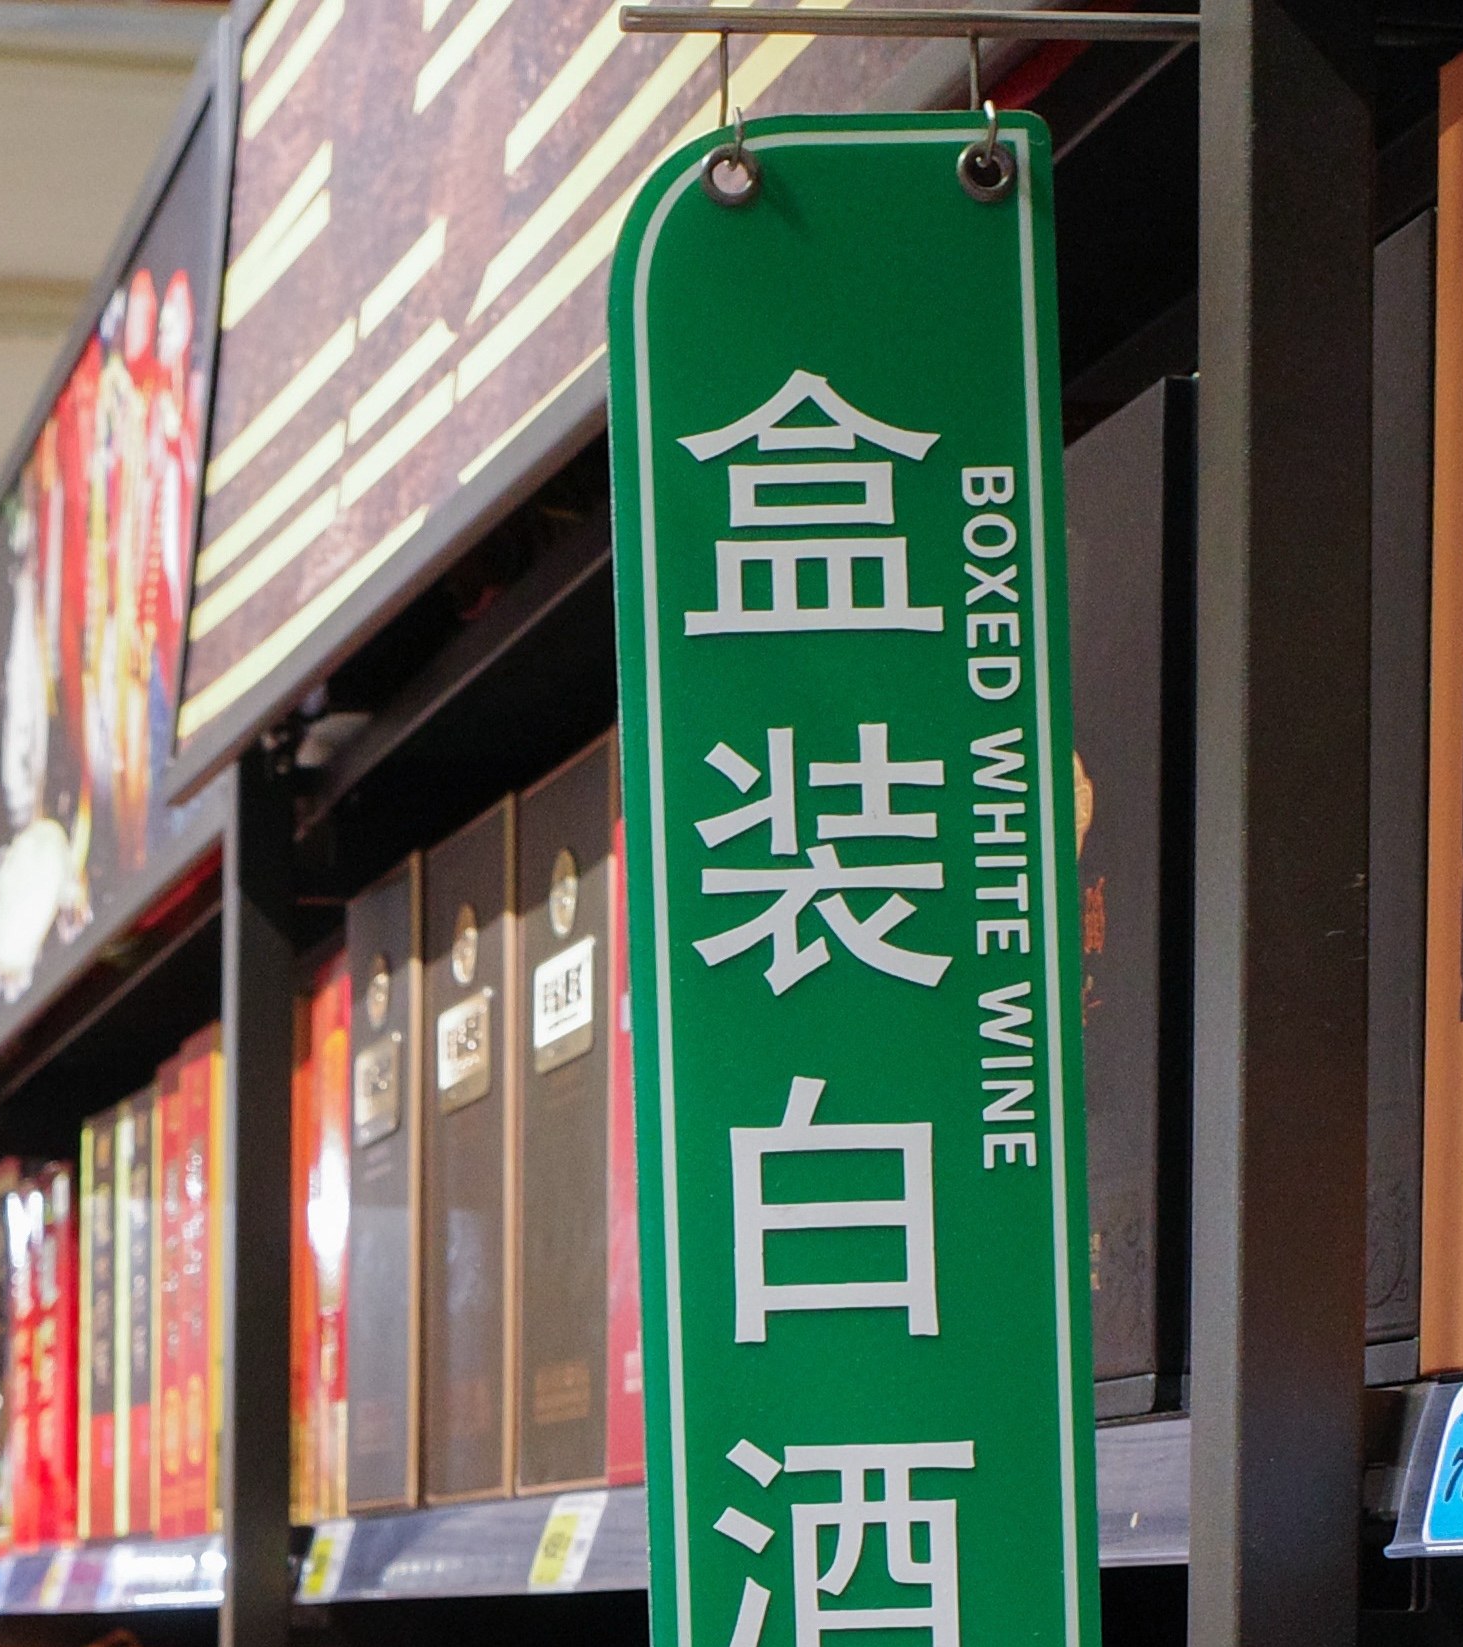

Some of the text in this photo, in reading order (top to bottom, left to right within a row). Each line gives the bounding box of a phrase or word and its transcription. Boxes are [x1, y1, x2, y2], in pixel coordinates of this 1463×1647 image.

[958, 464, 1039, 1170] BOXED WHITE WINE
